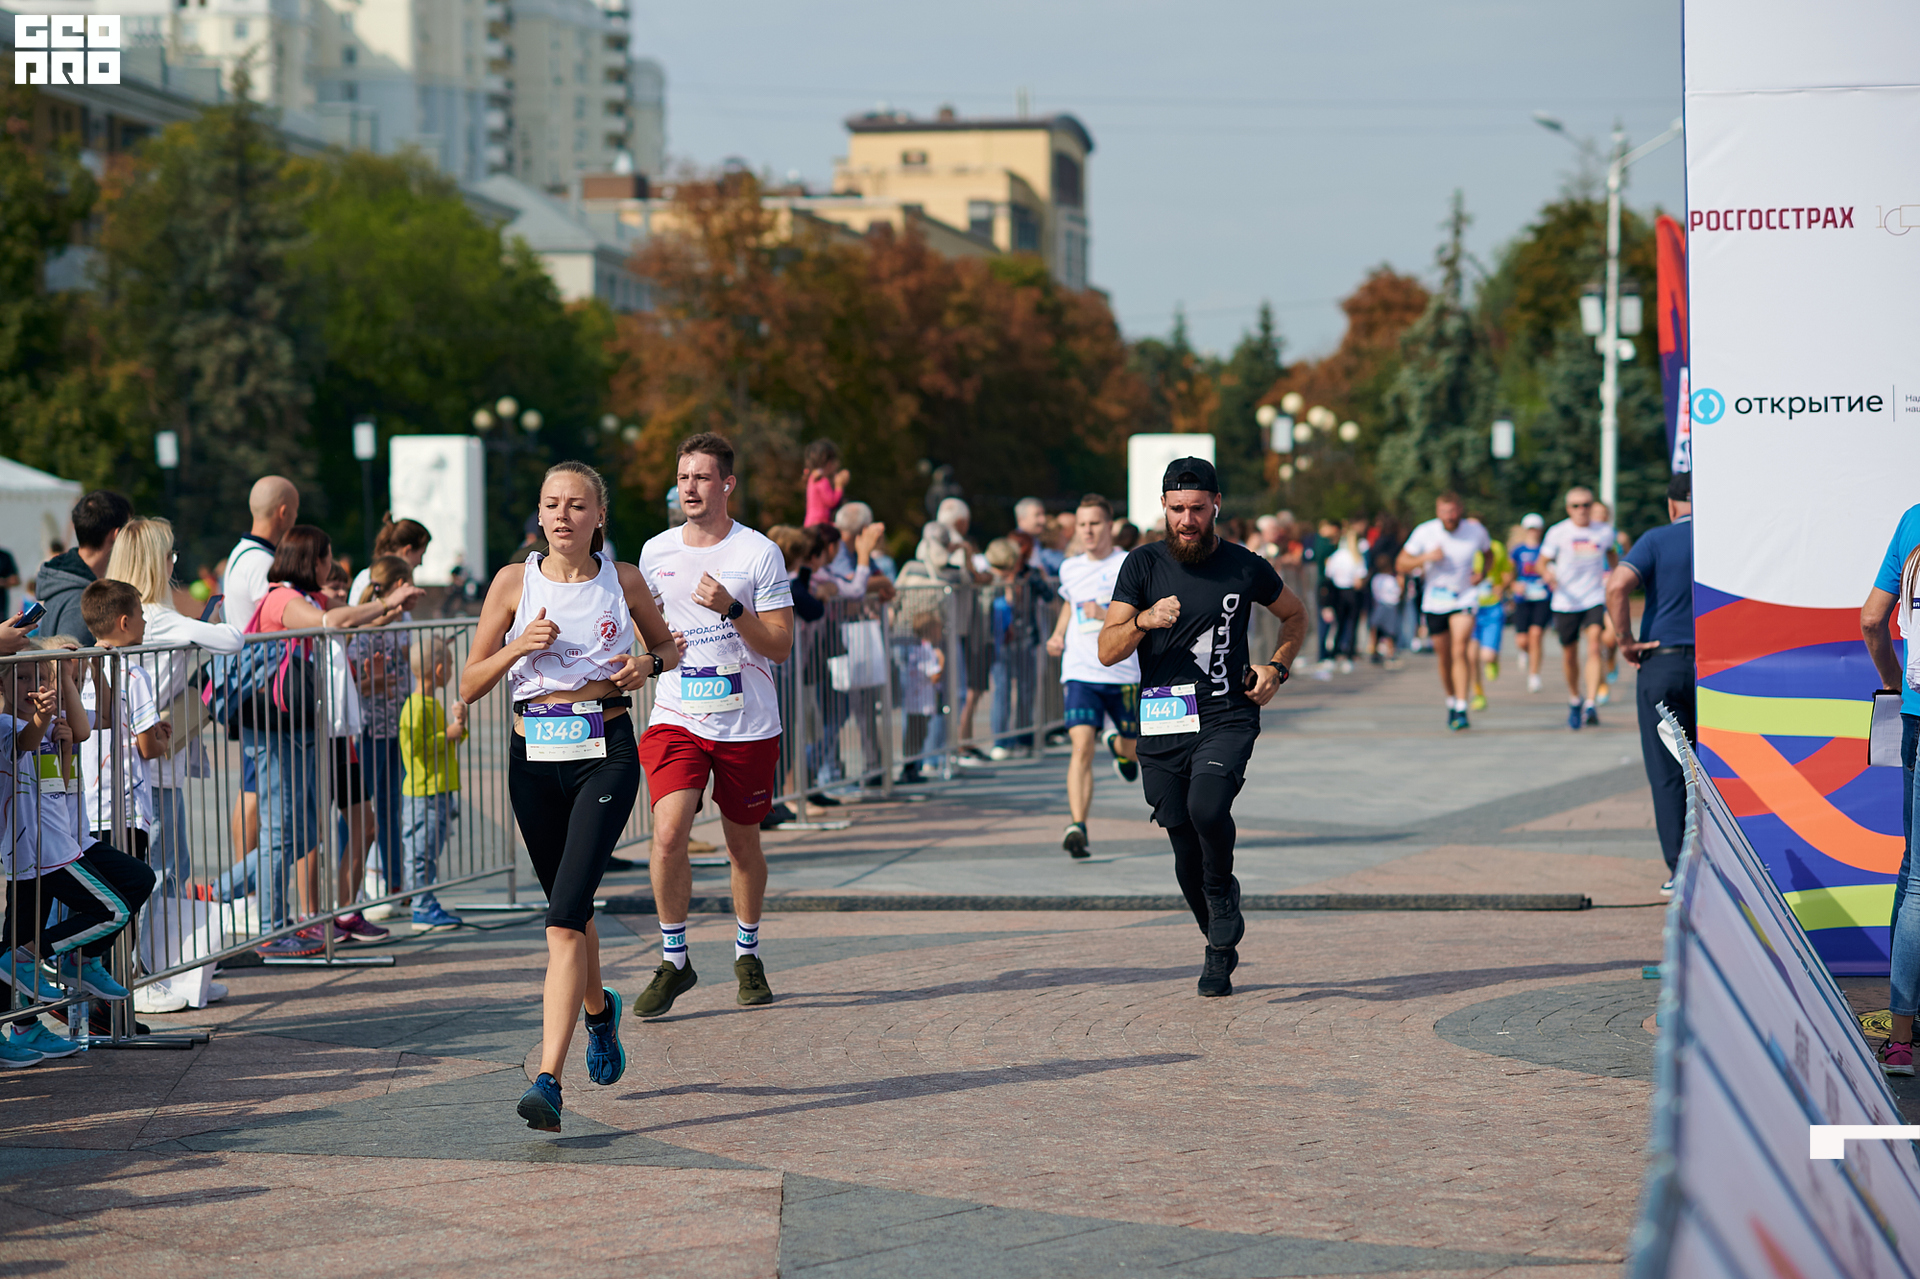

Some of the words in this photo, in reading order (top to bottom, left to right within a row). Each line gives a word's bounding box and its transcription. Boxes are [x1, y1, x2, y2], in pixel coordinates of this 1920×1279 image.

[1690, 206, 1855, 232] РОСГОССТРАХ
[1734, 394, 1884, 420] открытие
[687, 680, 725, 698] 1020
[1145, 700, 1178, 719] 1441
[534, 720, 584, 741] 1348
